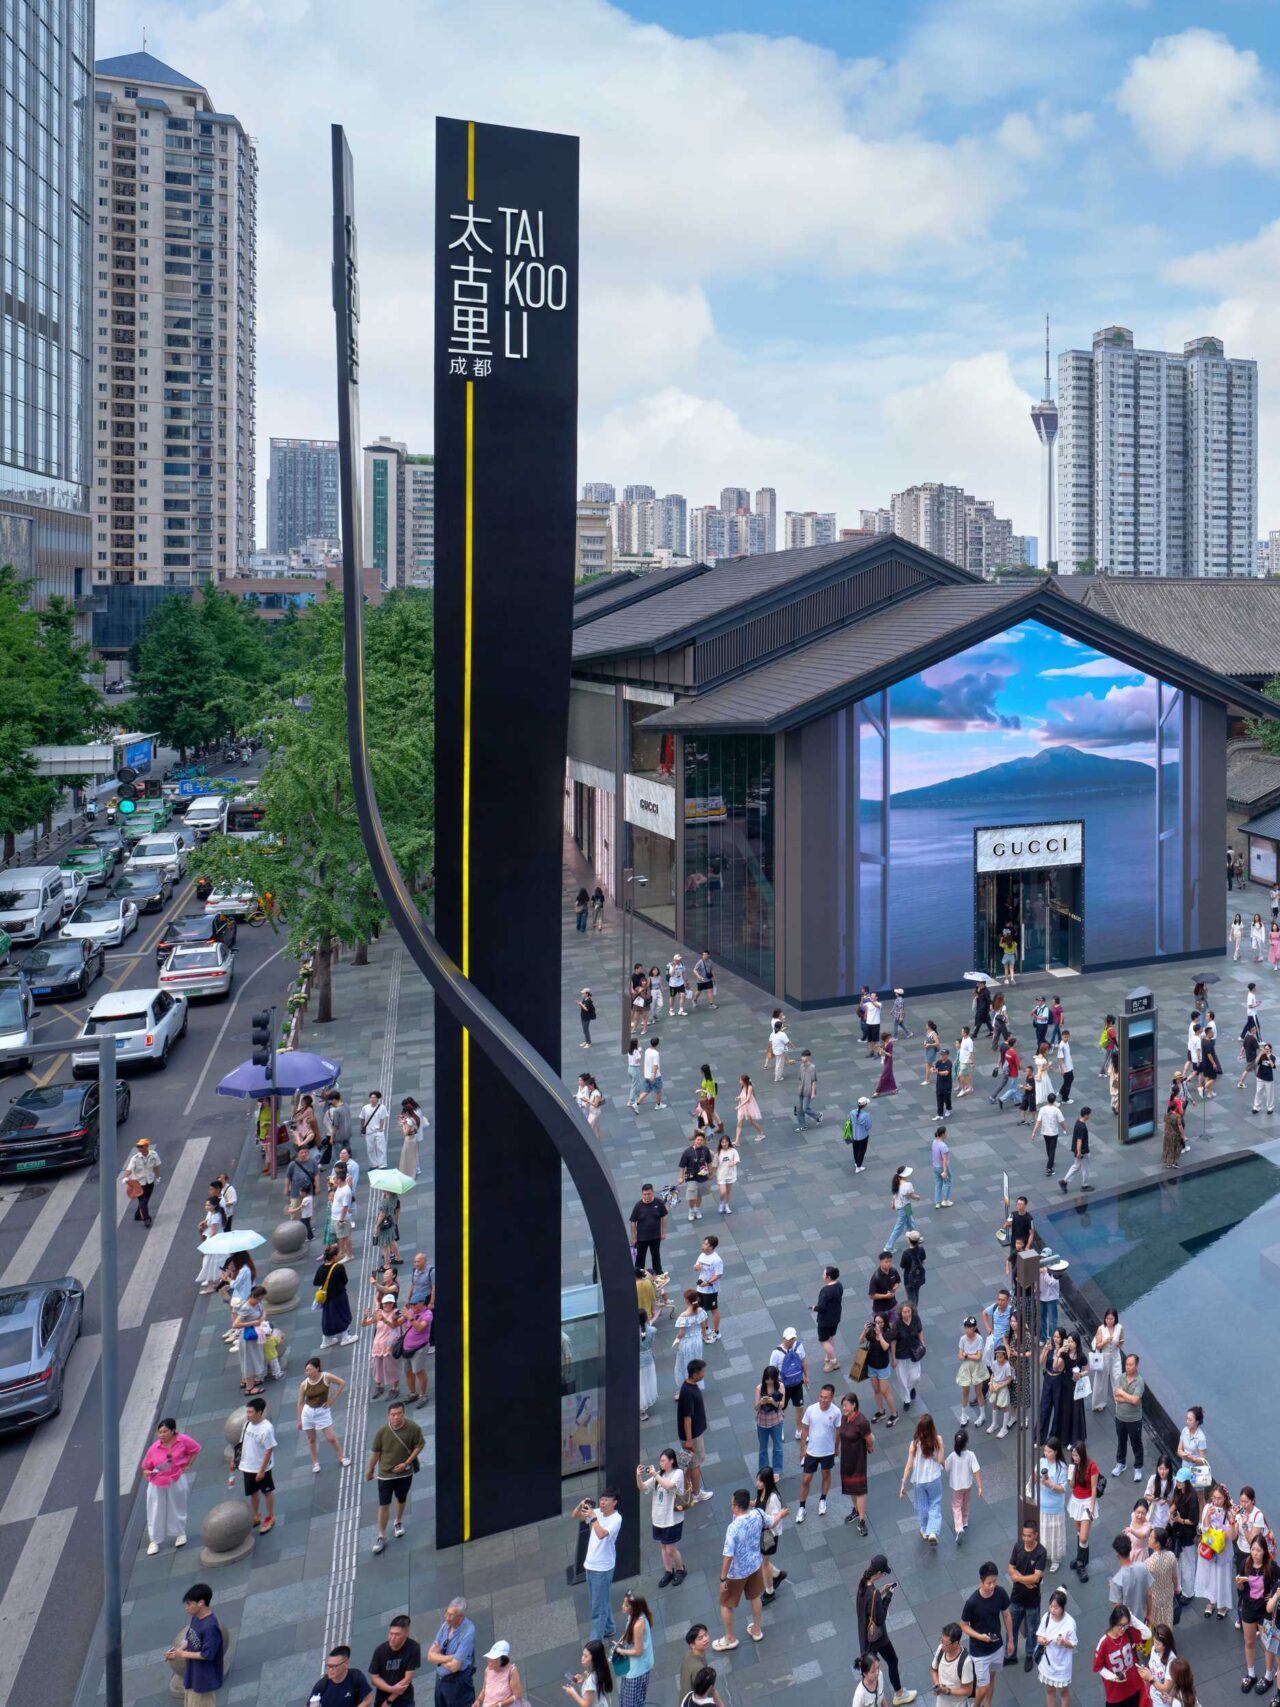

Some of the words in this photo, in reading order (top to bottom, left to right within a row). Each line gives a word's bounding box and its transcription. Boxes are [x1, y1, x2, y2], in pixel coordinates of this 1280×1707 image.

[498, 207, 544, 258] TAI
[448, 204, 493, 356] 太古里
[504, 260, 567, 311] KOO
[504, 310, 528, 359] LI
[449, 356, 492, 377] 成都
[640, 798, 659, 815] GUCCI
[992, 838, 1067, 857] GUCCI
[1108, 1642, 1133, 1672] 58
